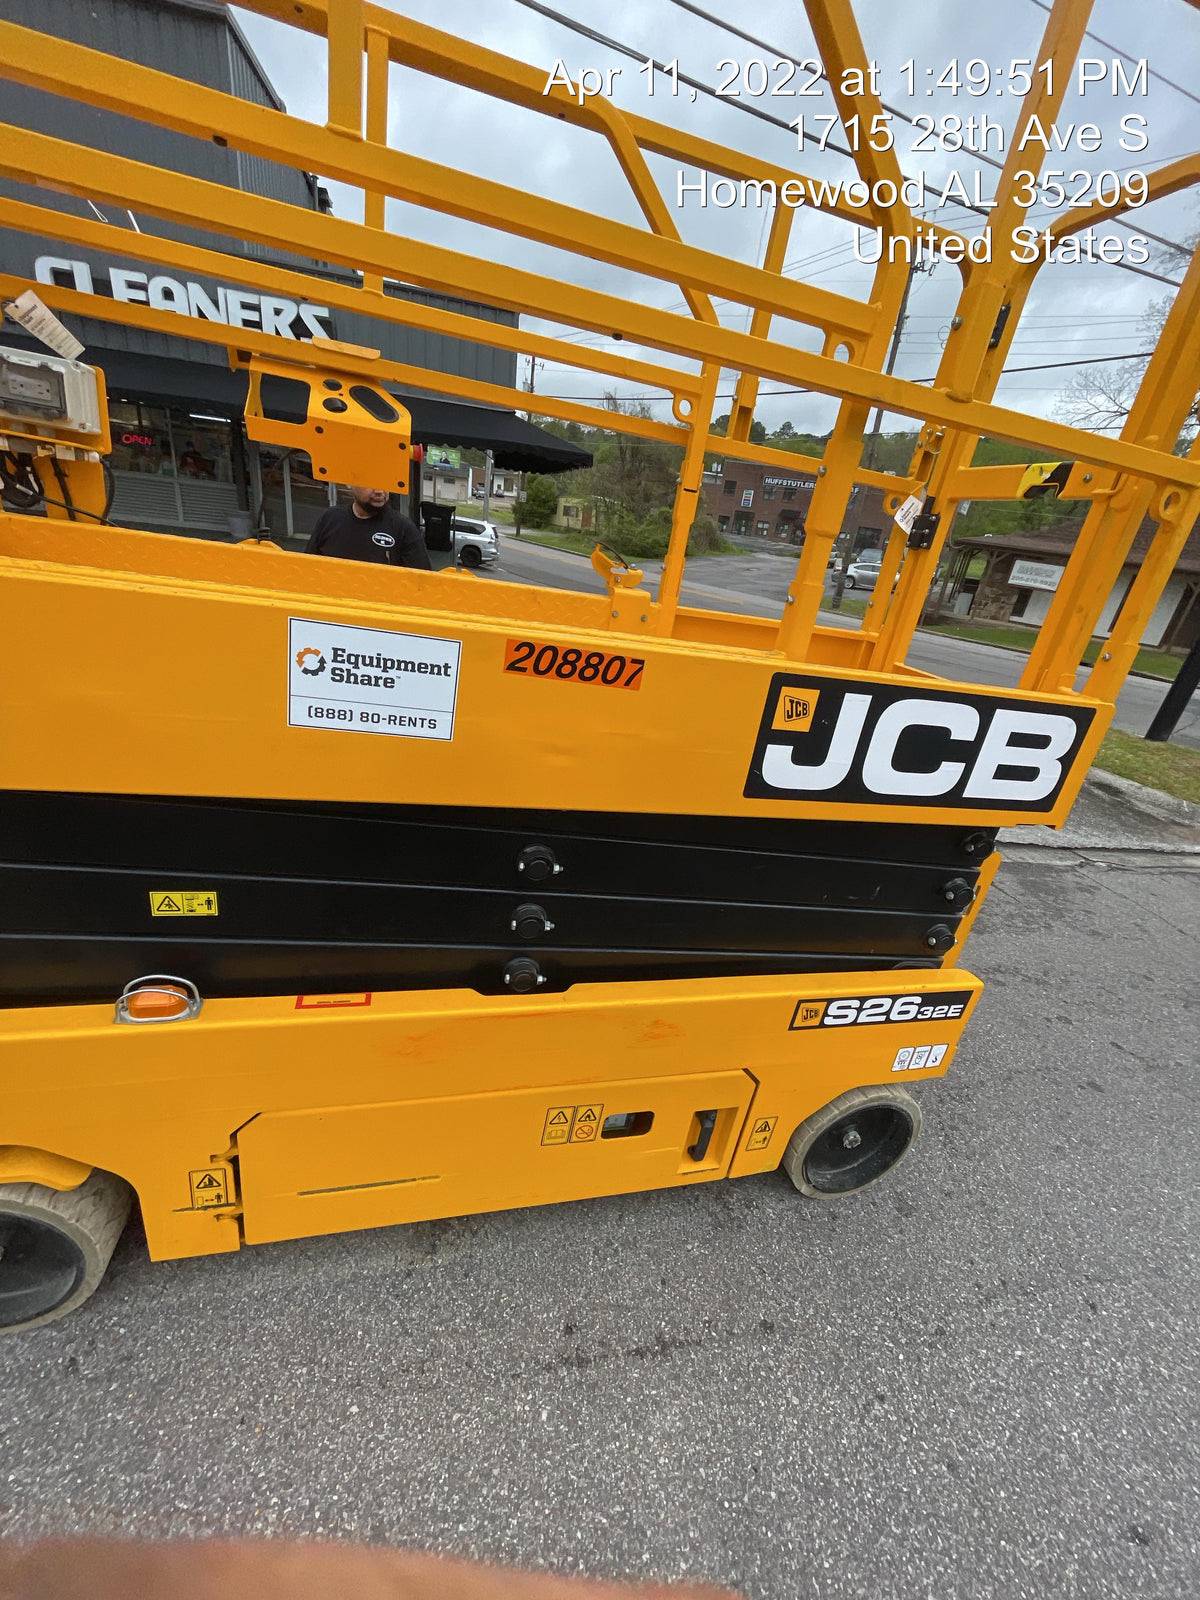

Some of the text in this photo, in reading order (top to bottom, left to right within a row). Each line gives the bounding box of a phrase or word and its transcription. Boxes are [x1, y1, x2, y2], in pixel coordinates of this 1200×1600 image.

[122, 433, 153, 446] OPEN
[331, 647, 452, 677] Equipment
[505, 641, 646, 687] 208807
[307, 705, 438, 730] (888) 80-RENTS
[786, 698, 808, 719] JCB
[761, 692, 1078, 801] JCB
[802, 1008, 819, 1020] JCB
